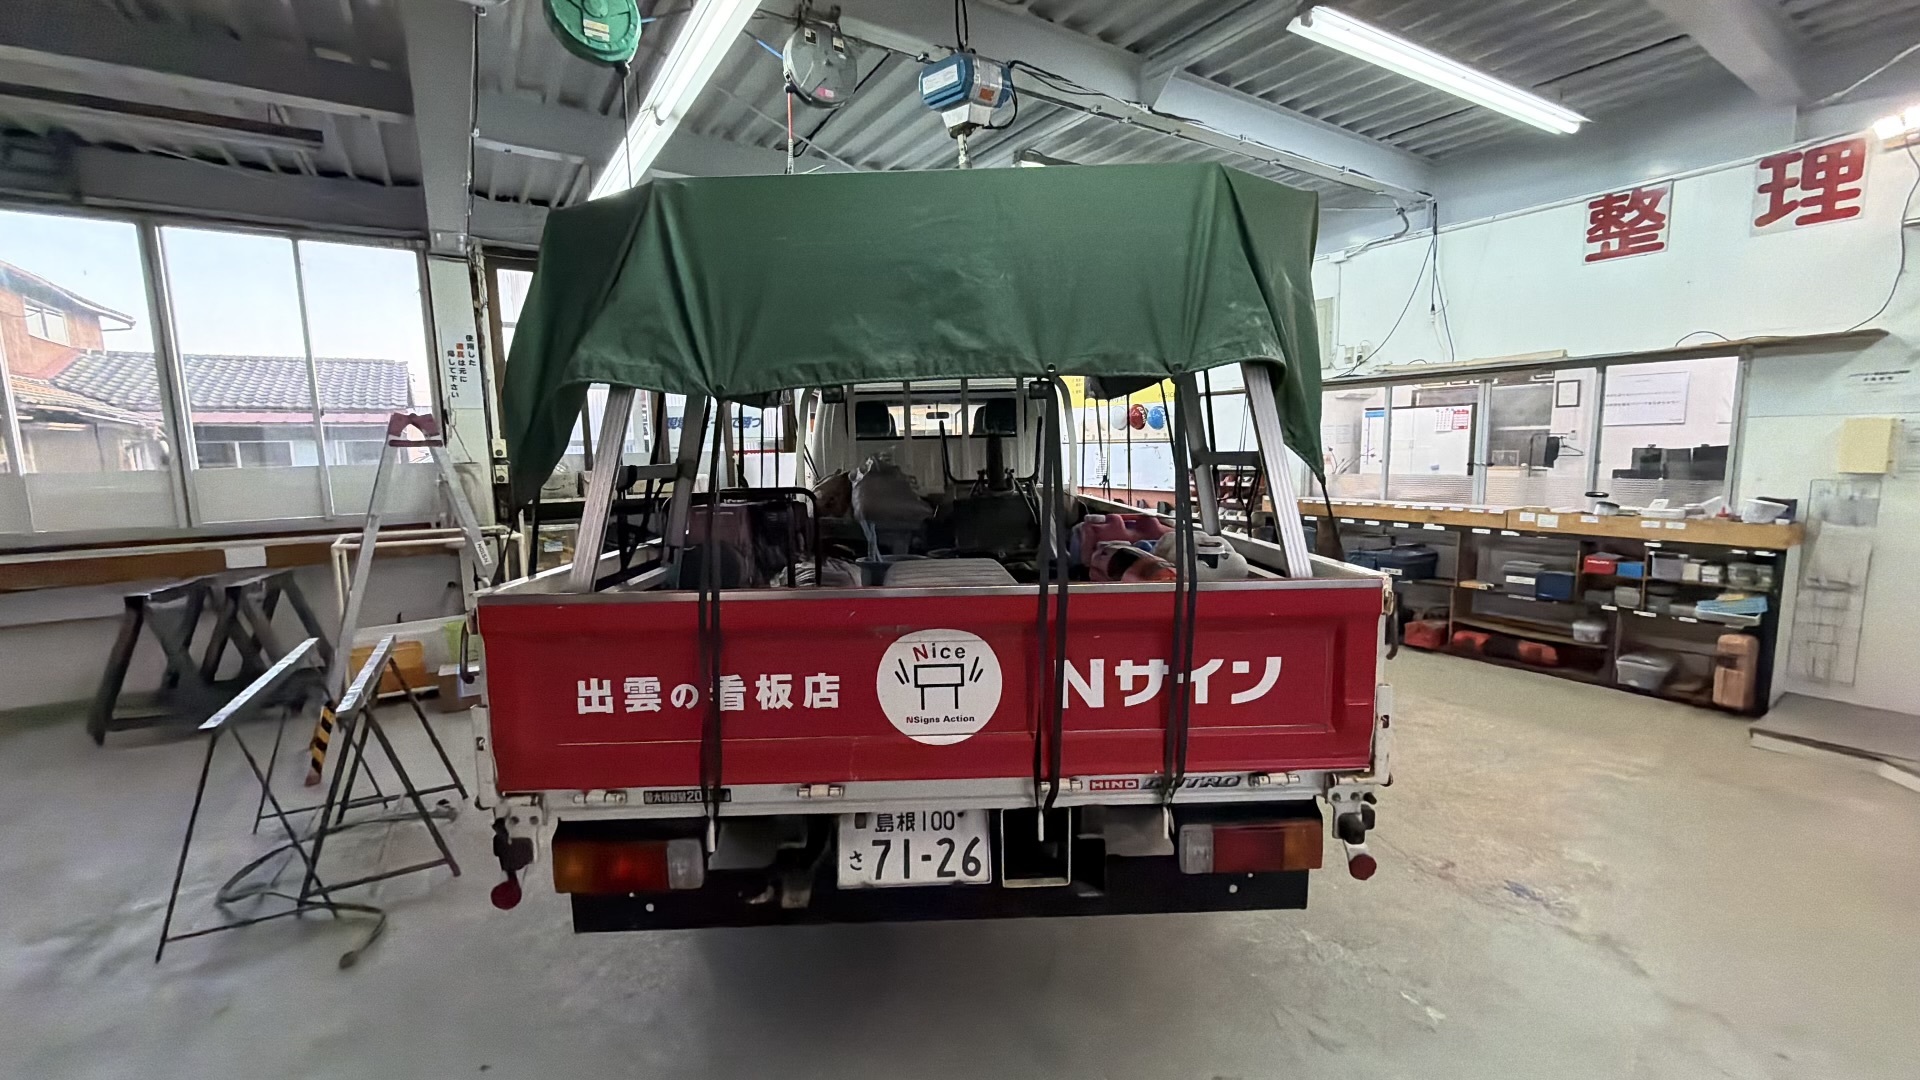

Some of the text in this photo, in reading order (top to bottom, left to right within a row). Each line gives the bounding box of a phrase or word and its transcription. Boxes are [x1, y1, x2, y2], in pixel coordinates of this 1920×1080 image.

[1585, 137, 1867, 262] 整 理
[912, 643, 966, 662] Nice
[577, 672, 840, 714] 出雲の看板店
[906, 714, 975, 724] NSigns Action
[1091, 779, 1138, 790] HINO
[849, 836, 981, 880] さ 71-26
